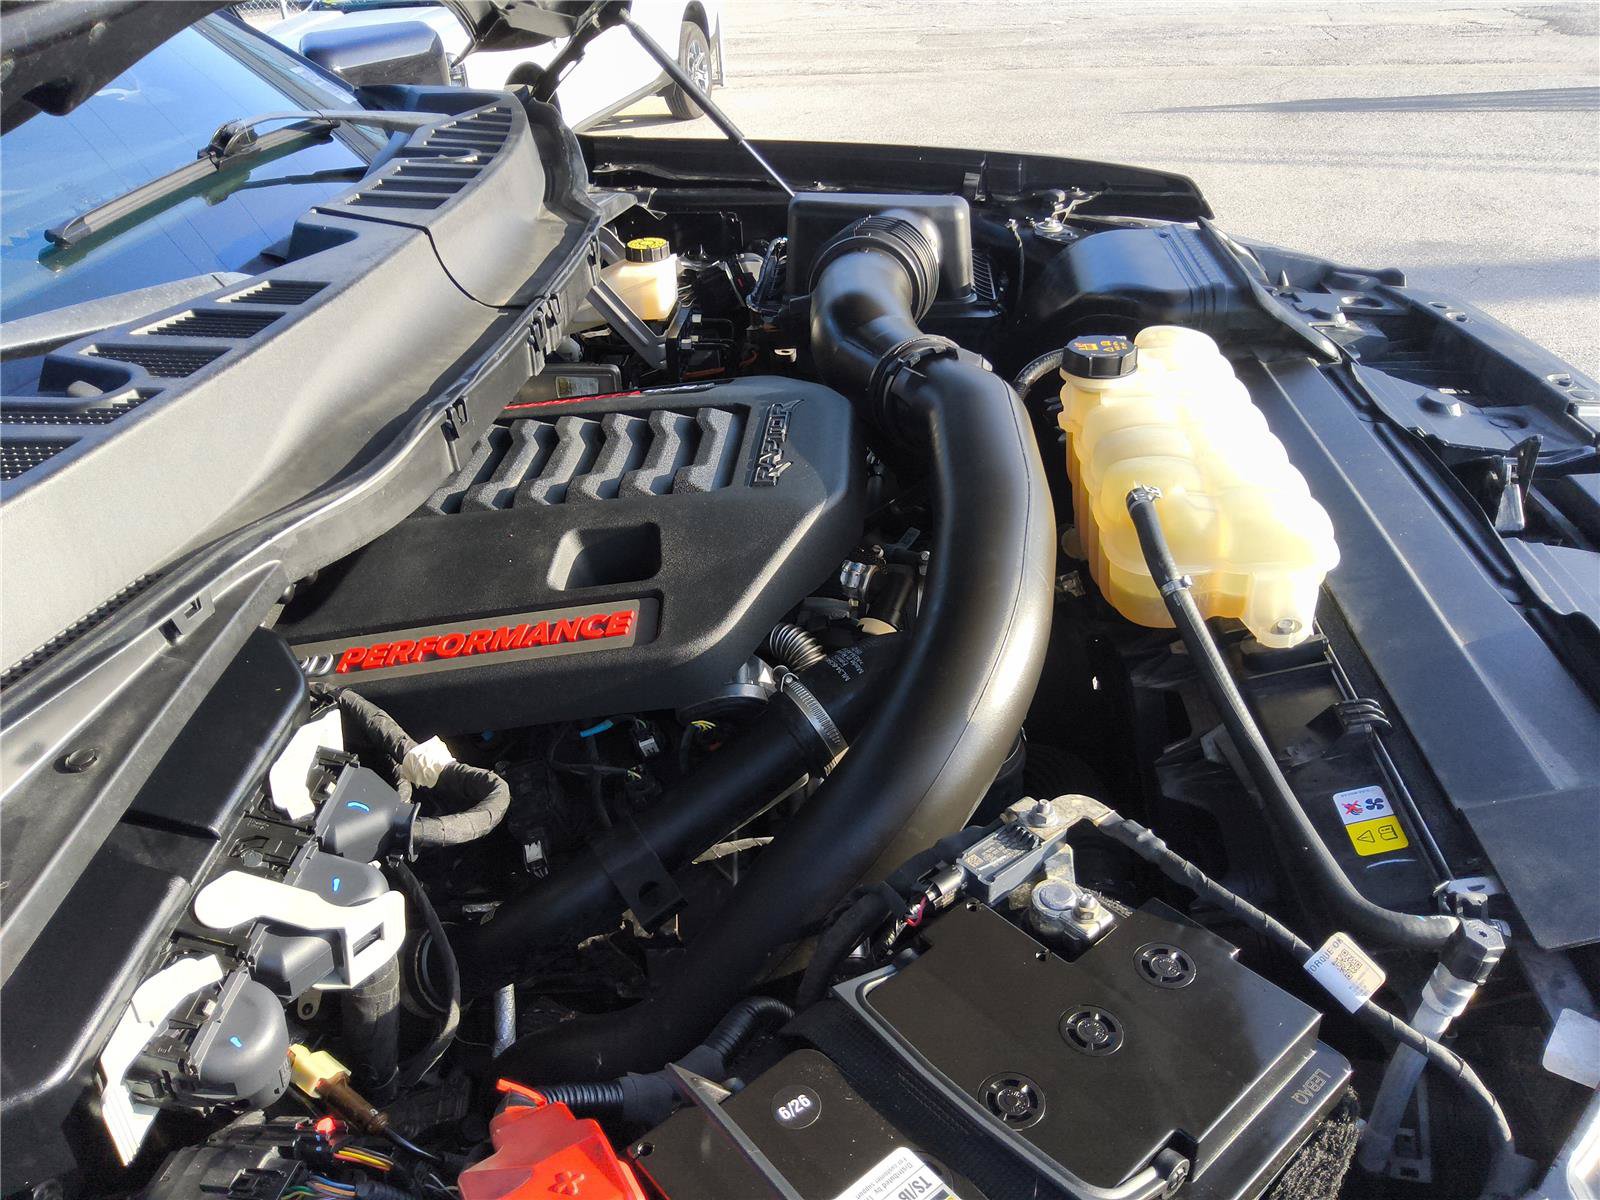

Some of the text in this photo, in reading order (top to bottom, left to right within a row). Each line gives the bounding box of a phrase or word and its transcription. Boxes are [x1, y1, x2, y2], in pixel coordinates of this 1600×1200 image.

[754, 401, 799, 484] RAPTOR
[335, 610, 635, 674] PERFORMANCE
[779, 1094, 811, 1119] 6/26
[881, 1161, 913, 1189] Distributed
